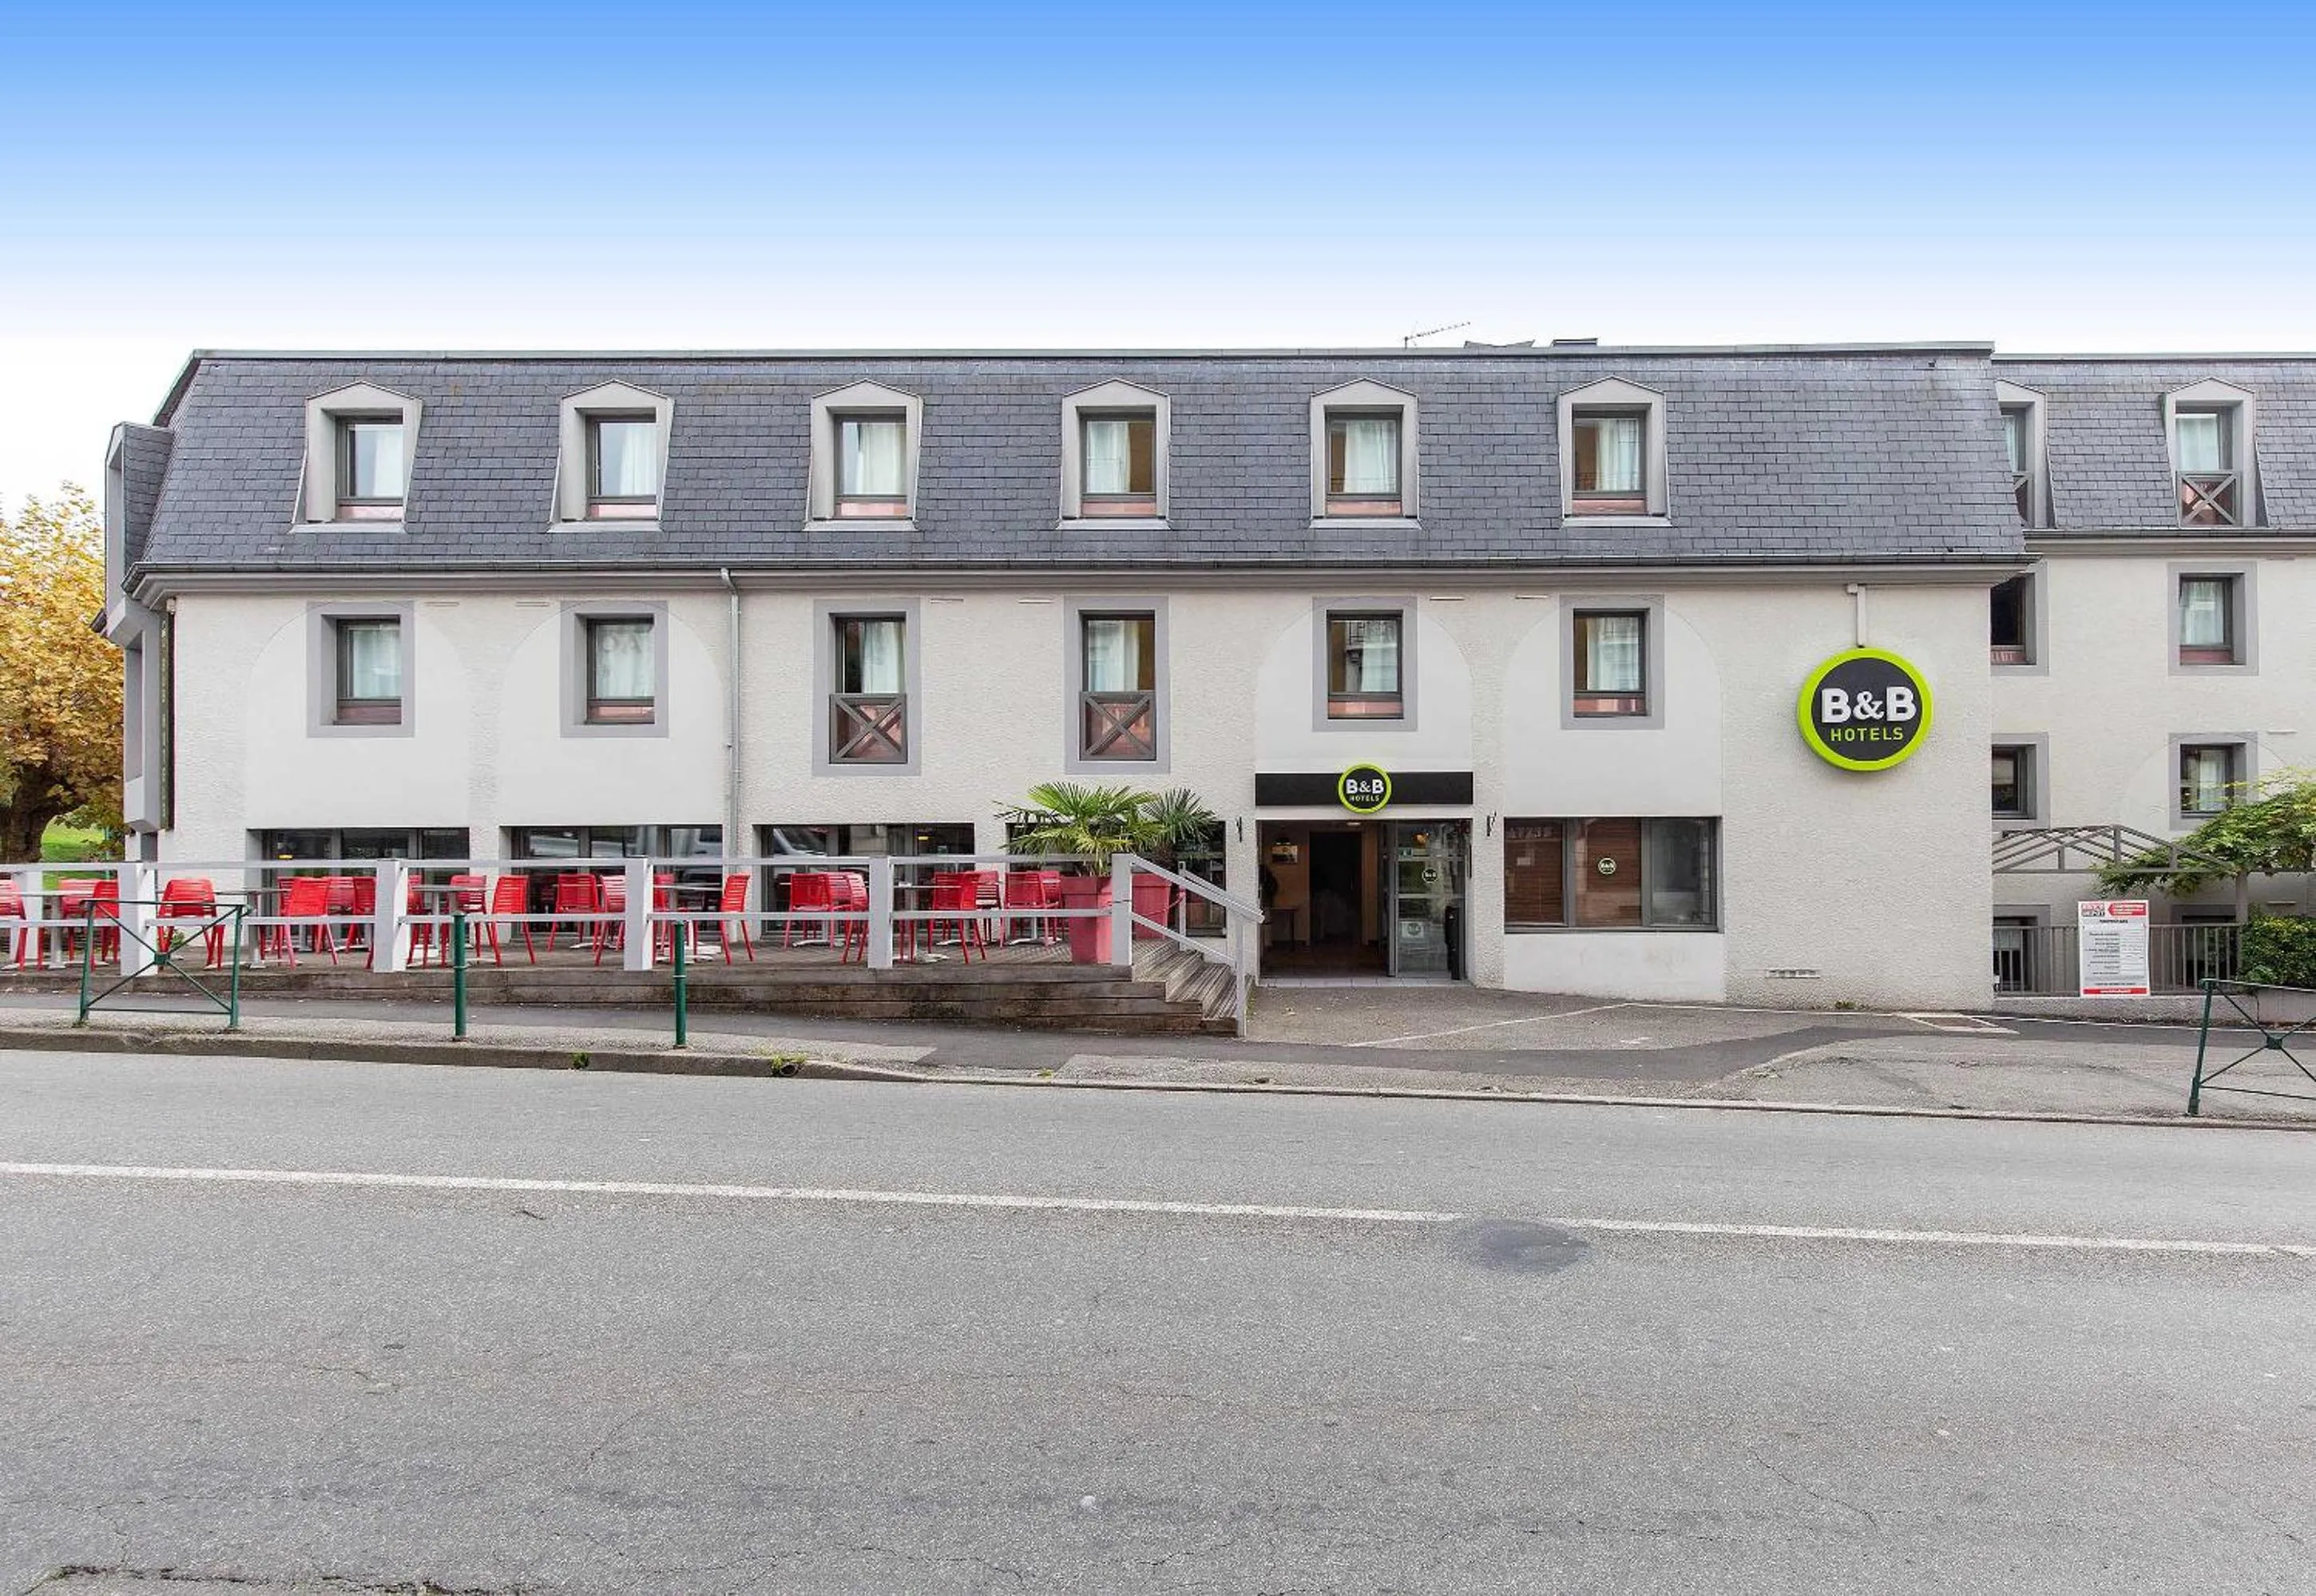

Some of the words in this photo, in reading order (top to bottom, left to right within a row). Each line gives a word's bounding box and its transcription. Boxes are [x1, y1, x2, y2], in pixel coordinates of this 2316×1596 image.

[1821, 686, 1917, 723] B&B
[1830, 727, 1904, 742] HOTELS
[1346, 778, 1384, 794] B&B
